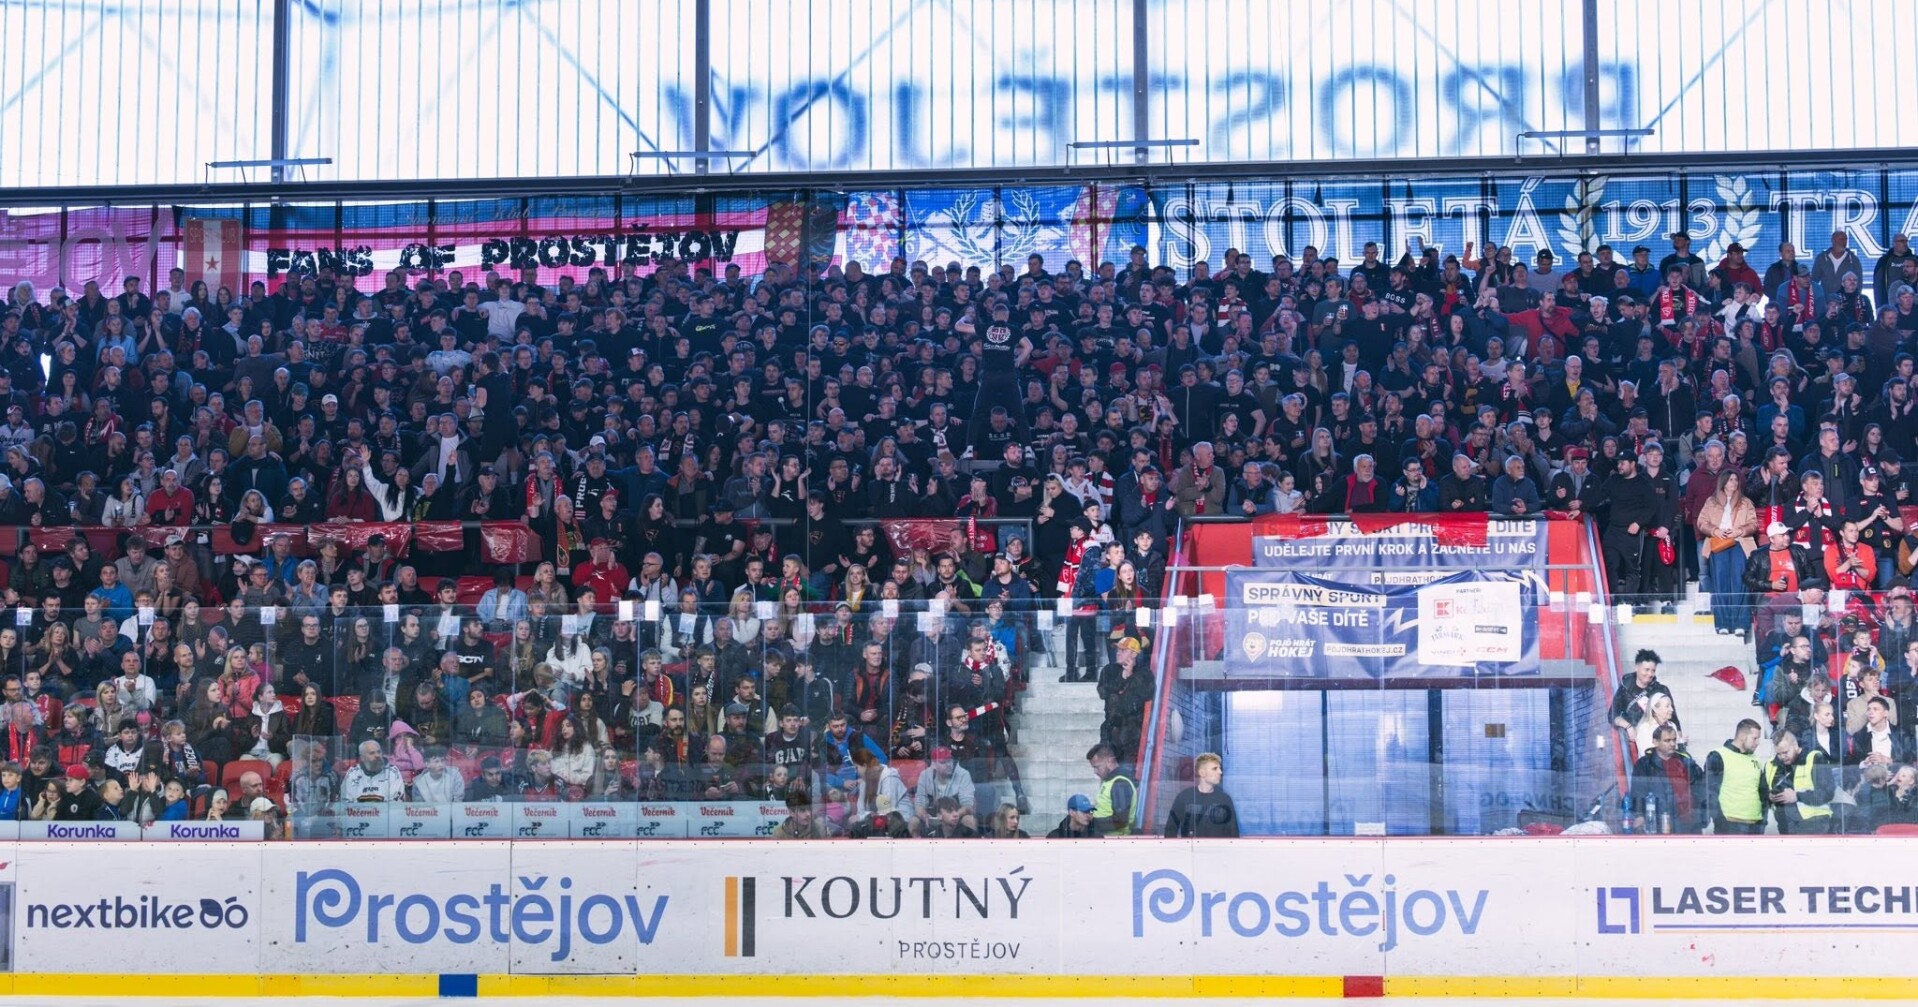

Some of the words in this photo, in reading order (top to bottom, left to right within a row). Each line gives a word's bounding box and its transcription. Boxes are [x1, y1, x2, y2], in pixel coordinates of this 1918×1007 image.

[1164, 176, 1561, 268] STOLETÁ
[1603, 198, 1718, 241] 1913
[267, 245, 374, 279] FANS
[400, 243, 455, 275] OF
[1385, 292, 1406, 304] BOSS
[1264, 543, 1331, 556] UDĚLEJTE
[1335, 541, 1374, 556] PRVNÍ
[1378, 543, 1414, 555] KROK
[1418, 544, 1427, 554] A
[1495, 543, 1504, 554] U
[1509, 540, 1536, 554] NÁS
[1249, 586, 1322, 602] SPRÁVNÝ
[1333, 610, 1369, 627] DÍTĚ
[1267, 646, 1315, 657] HOKEJ
[47, 824, 116, 839] Korunka
[170, 824, 240, 839] Korunka
[781, 865, 1033, 919] KOUTNÝ
[1653, 886, 1786, 914] LASER
[1800, 886, 1918, 914] TECH
[28, 896, 193, 928] nextbike
[295, 868, 669, 962] Prostějov
[1132, 868, 1489, 952] Prostějov
[899, 938, 1020, 959] PROSTĚJOV
